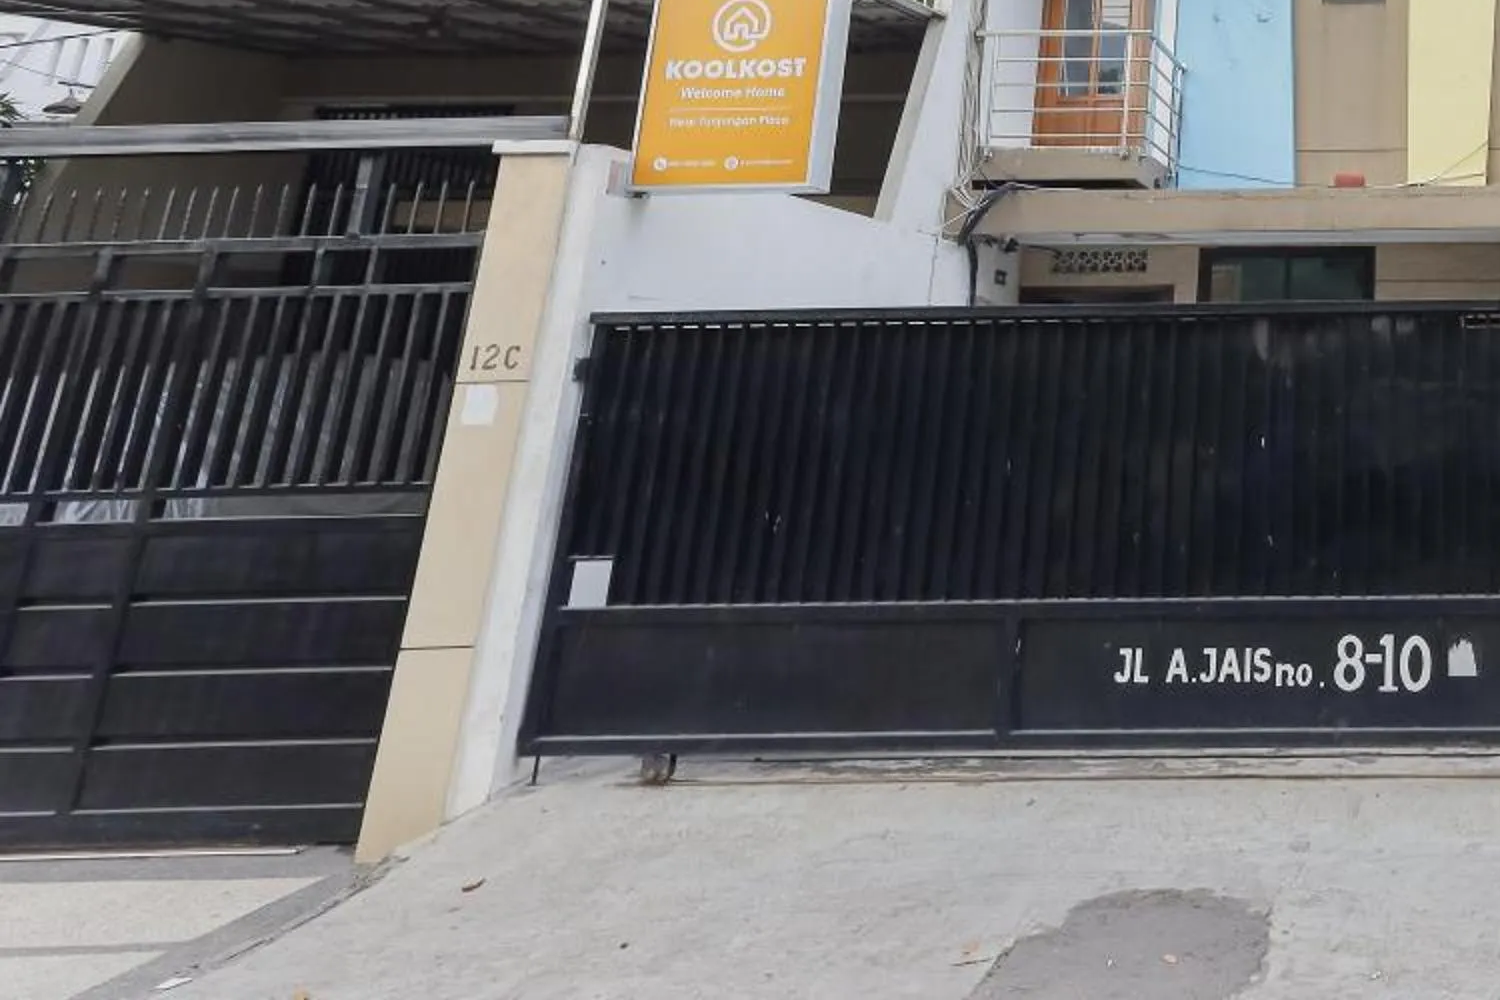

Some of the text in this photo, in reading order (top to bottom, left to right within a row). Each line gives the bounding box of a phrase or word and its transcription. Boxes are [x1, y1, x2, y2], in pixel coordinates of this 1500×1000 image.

[665, 57, 807, 80] KOOLKOST
[681, 86, 785, 99] Welcome Home
[470, 344, 521, 371] 12C
[1114, 647, 1150, 684] JL
[1333, 632, 1433, 694] 8-10
